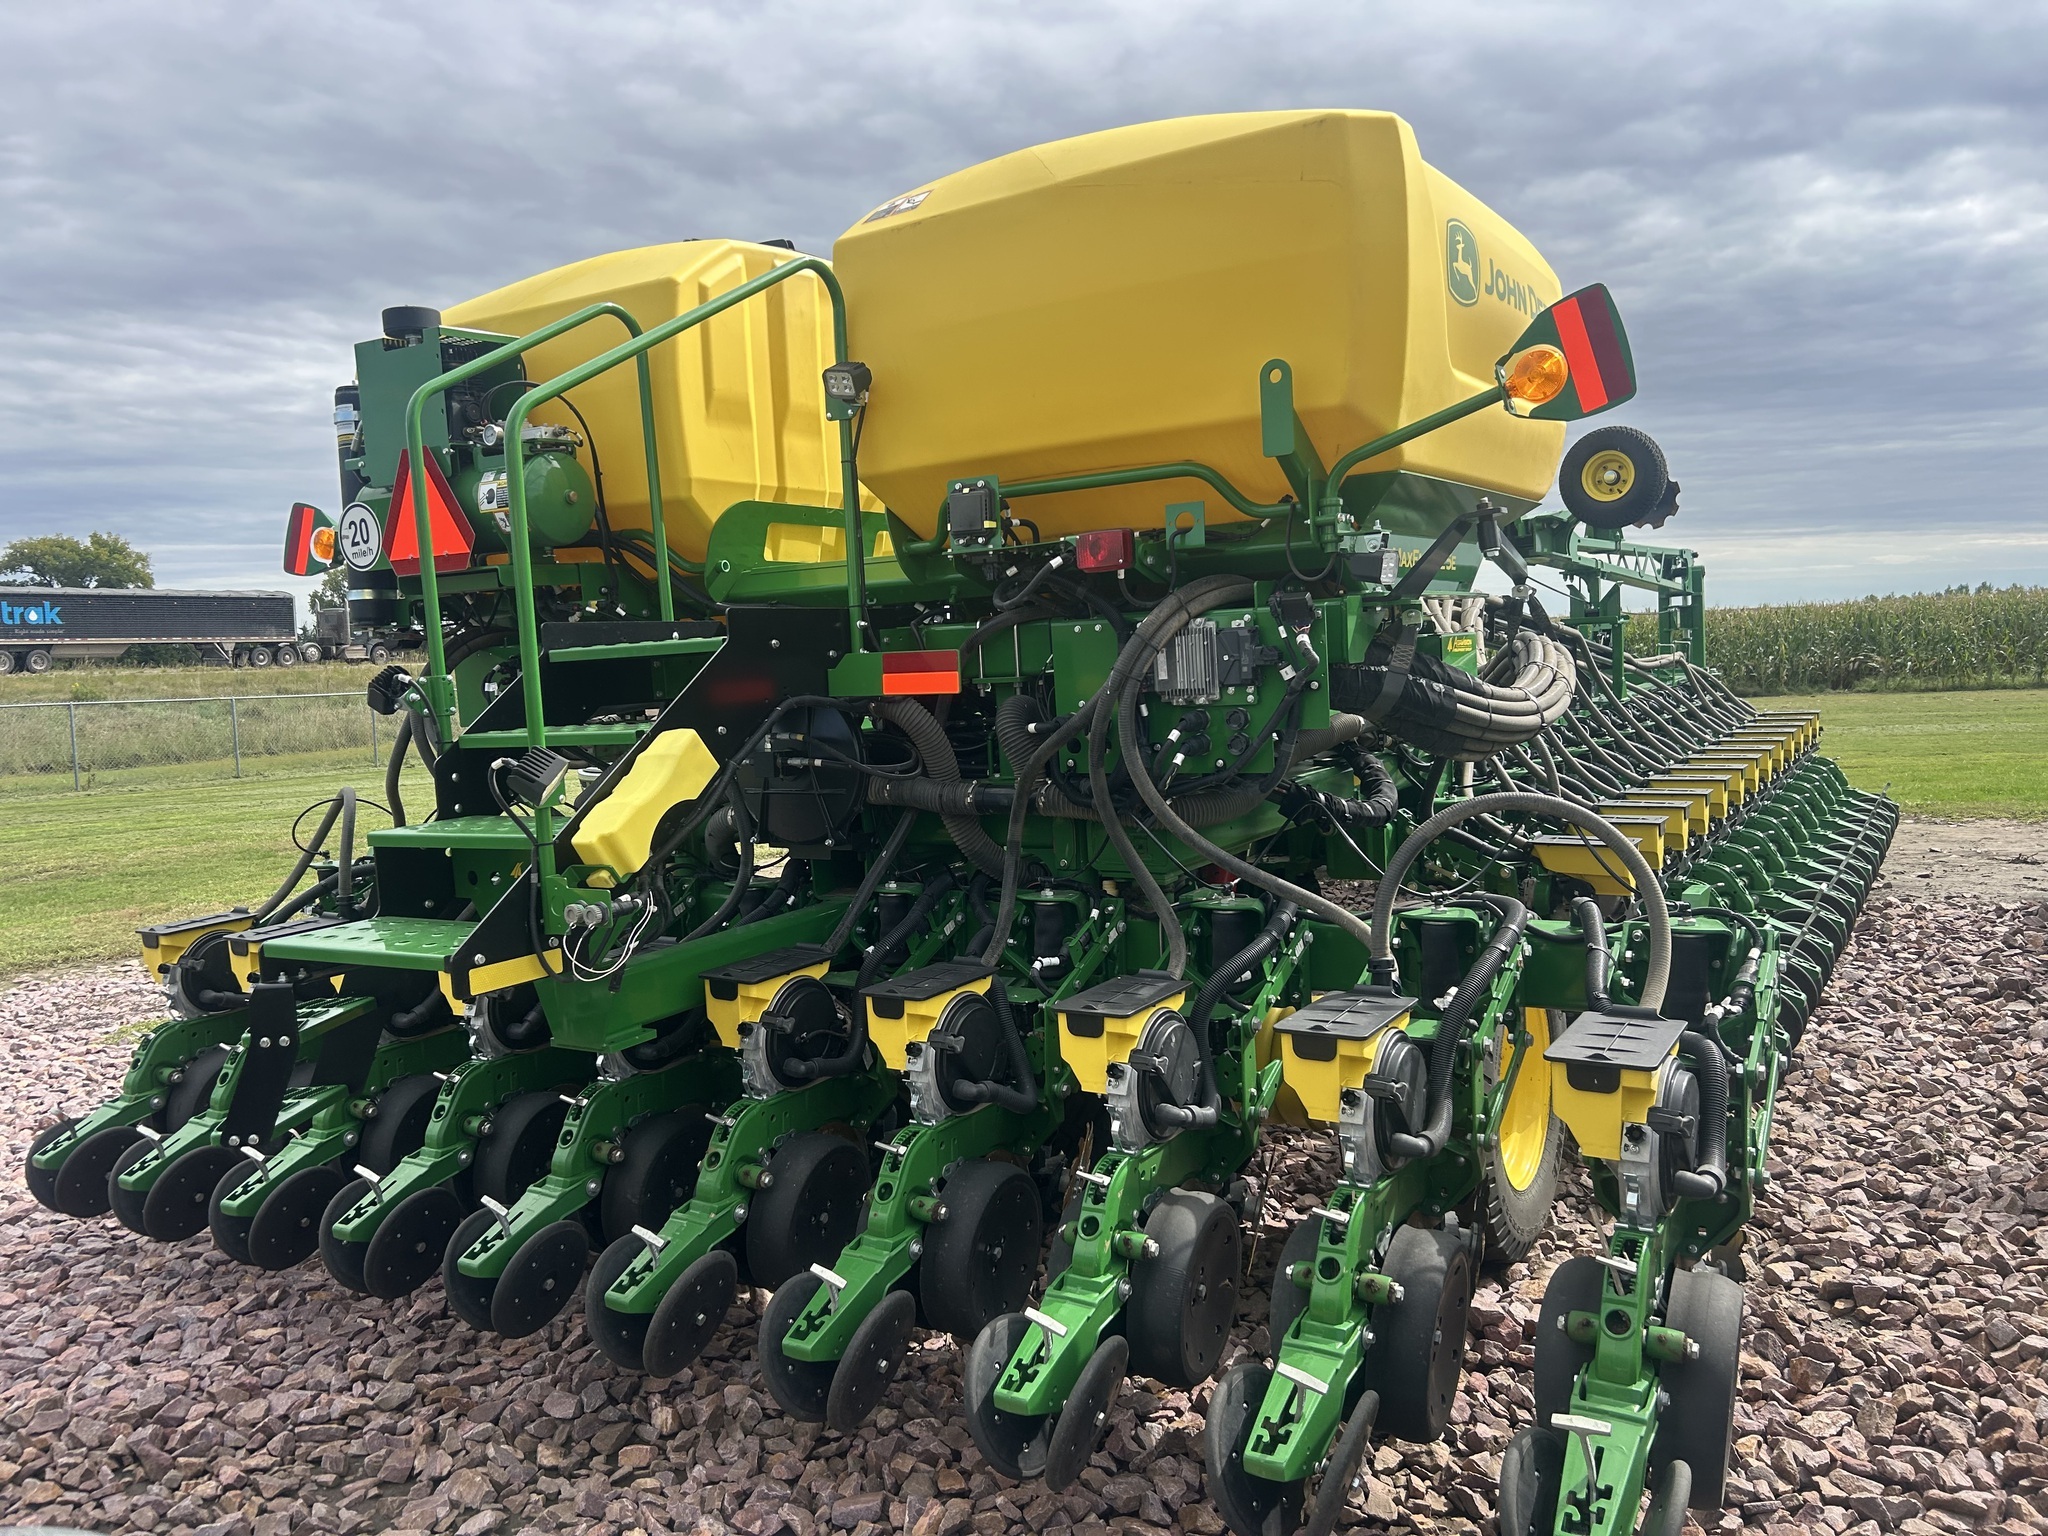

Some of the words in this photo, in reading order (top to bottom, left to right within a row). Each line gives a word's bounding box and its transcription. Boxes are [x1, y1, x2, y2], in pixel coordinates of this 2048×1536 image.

[1485, 258, 1527, 315] JOHN
[348, 517, 370, 547] 20
[352, 547, 374, 560] mile/h
[1, 601, 63, 625] trak
